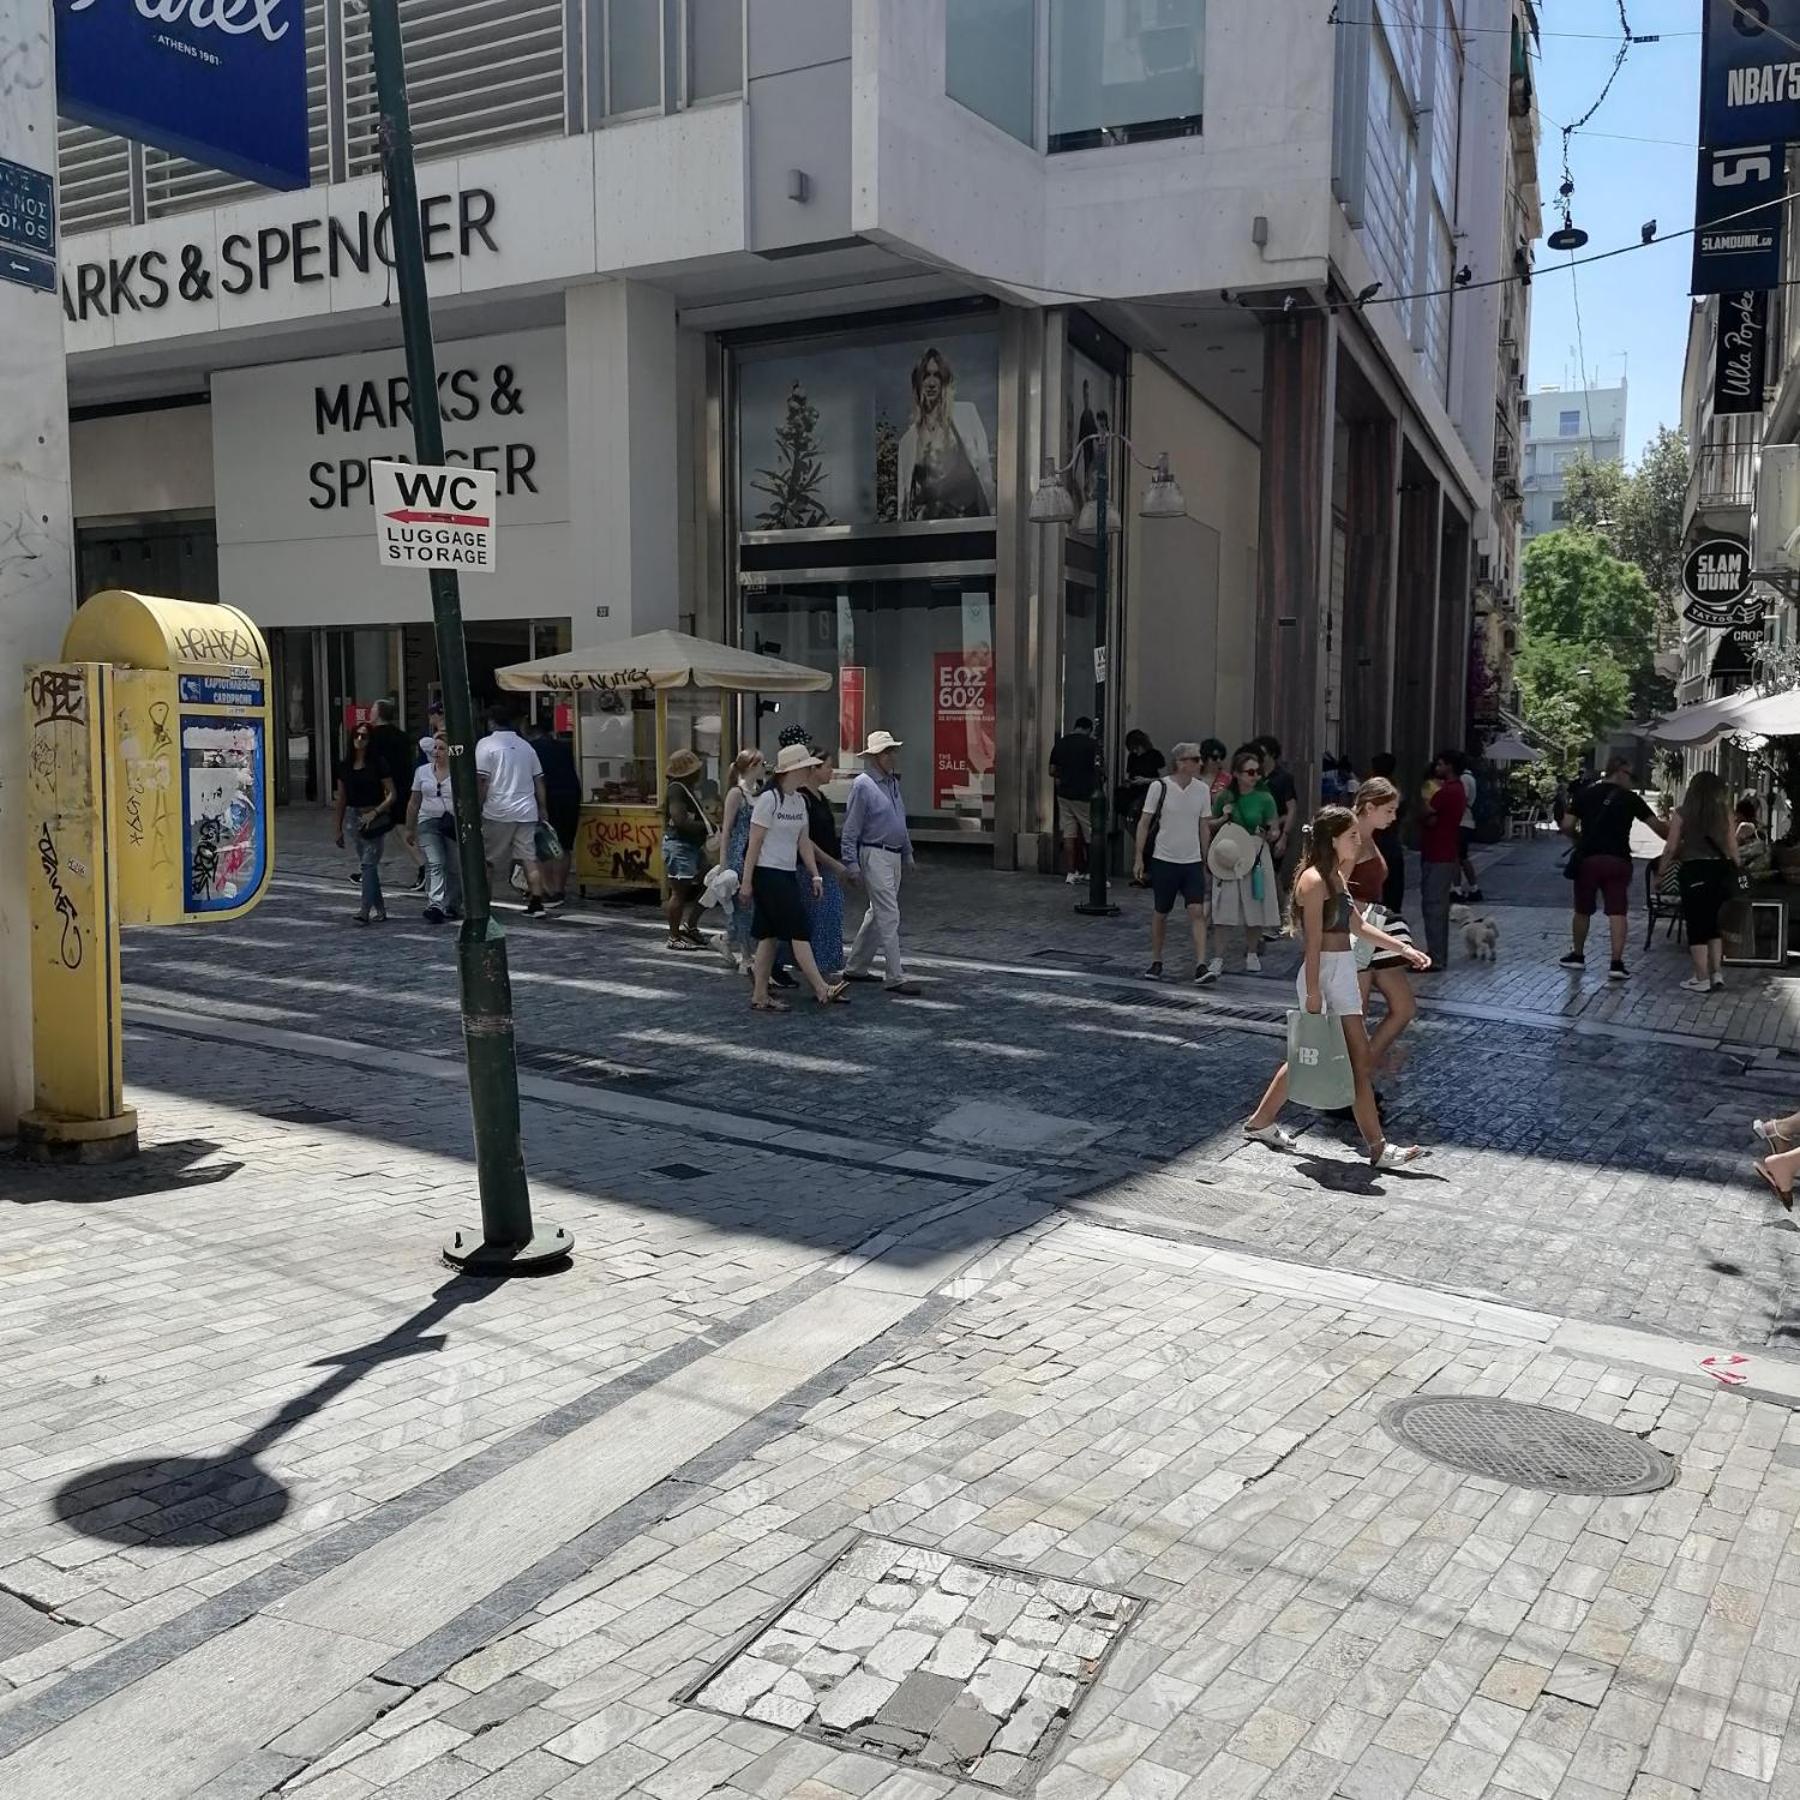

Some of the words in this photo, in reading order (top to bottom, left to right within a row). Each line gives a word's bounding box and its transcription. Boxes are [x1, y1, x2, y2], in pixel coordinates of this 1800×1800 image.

[1727, 62, 1800, 107] NBA75
[179, 244, 213, 301] &
[1722, 351, 1752, 396] Ulla
[491, 365, 524, 415] &
[309, 443, 538, 509] SPER
[394, 471, 477, 511] WC
[387, 527, 487, 548] LUGGAGE
[389, 545, 487, 565] STORAGE
[1697, 554, 1742, 573] SLAM
[1696, 573, 1740, 591] DUNK
[1692, 608, 1734, 623] TATTOO
[939, 687, 985, 708] 60%
